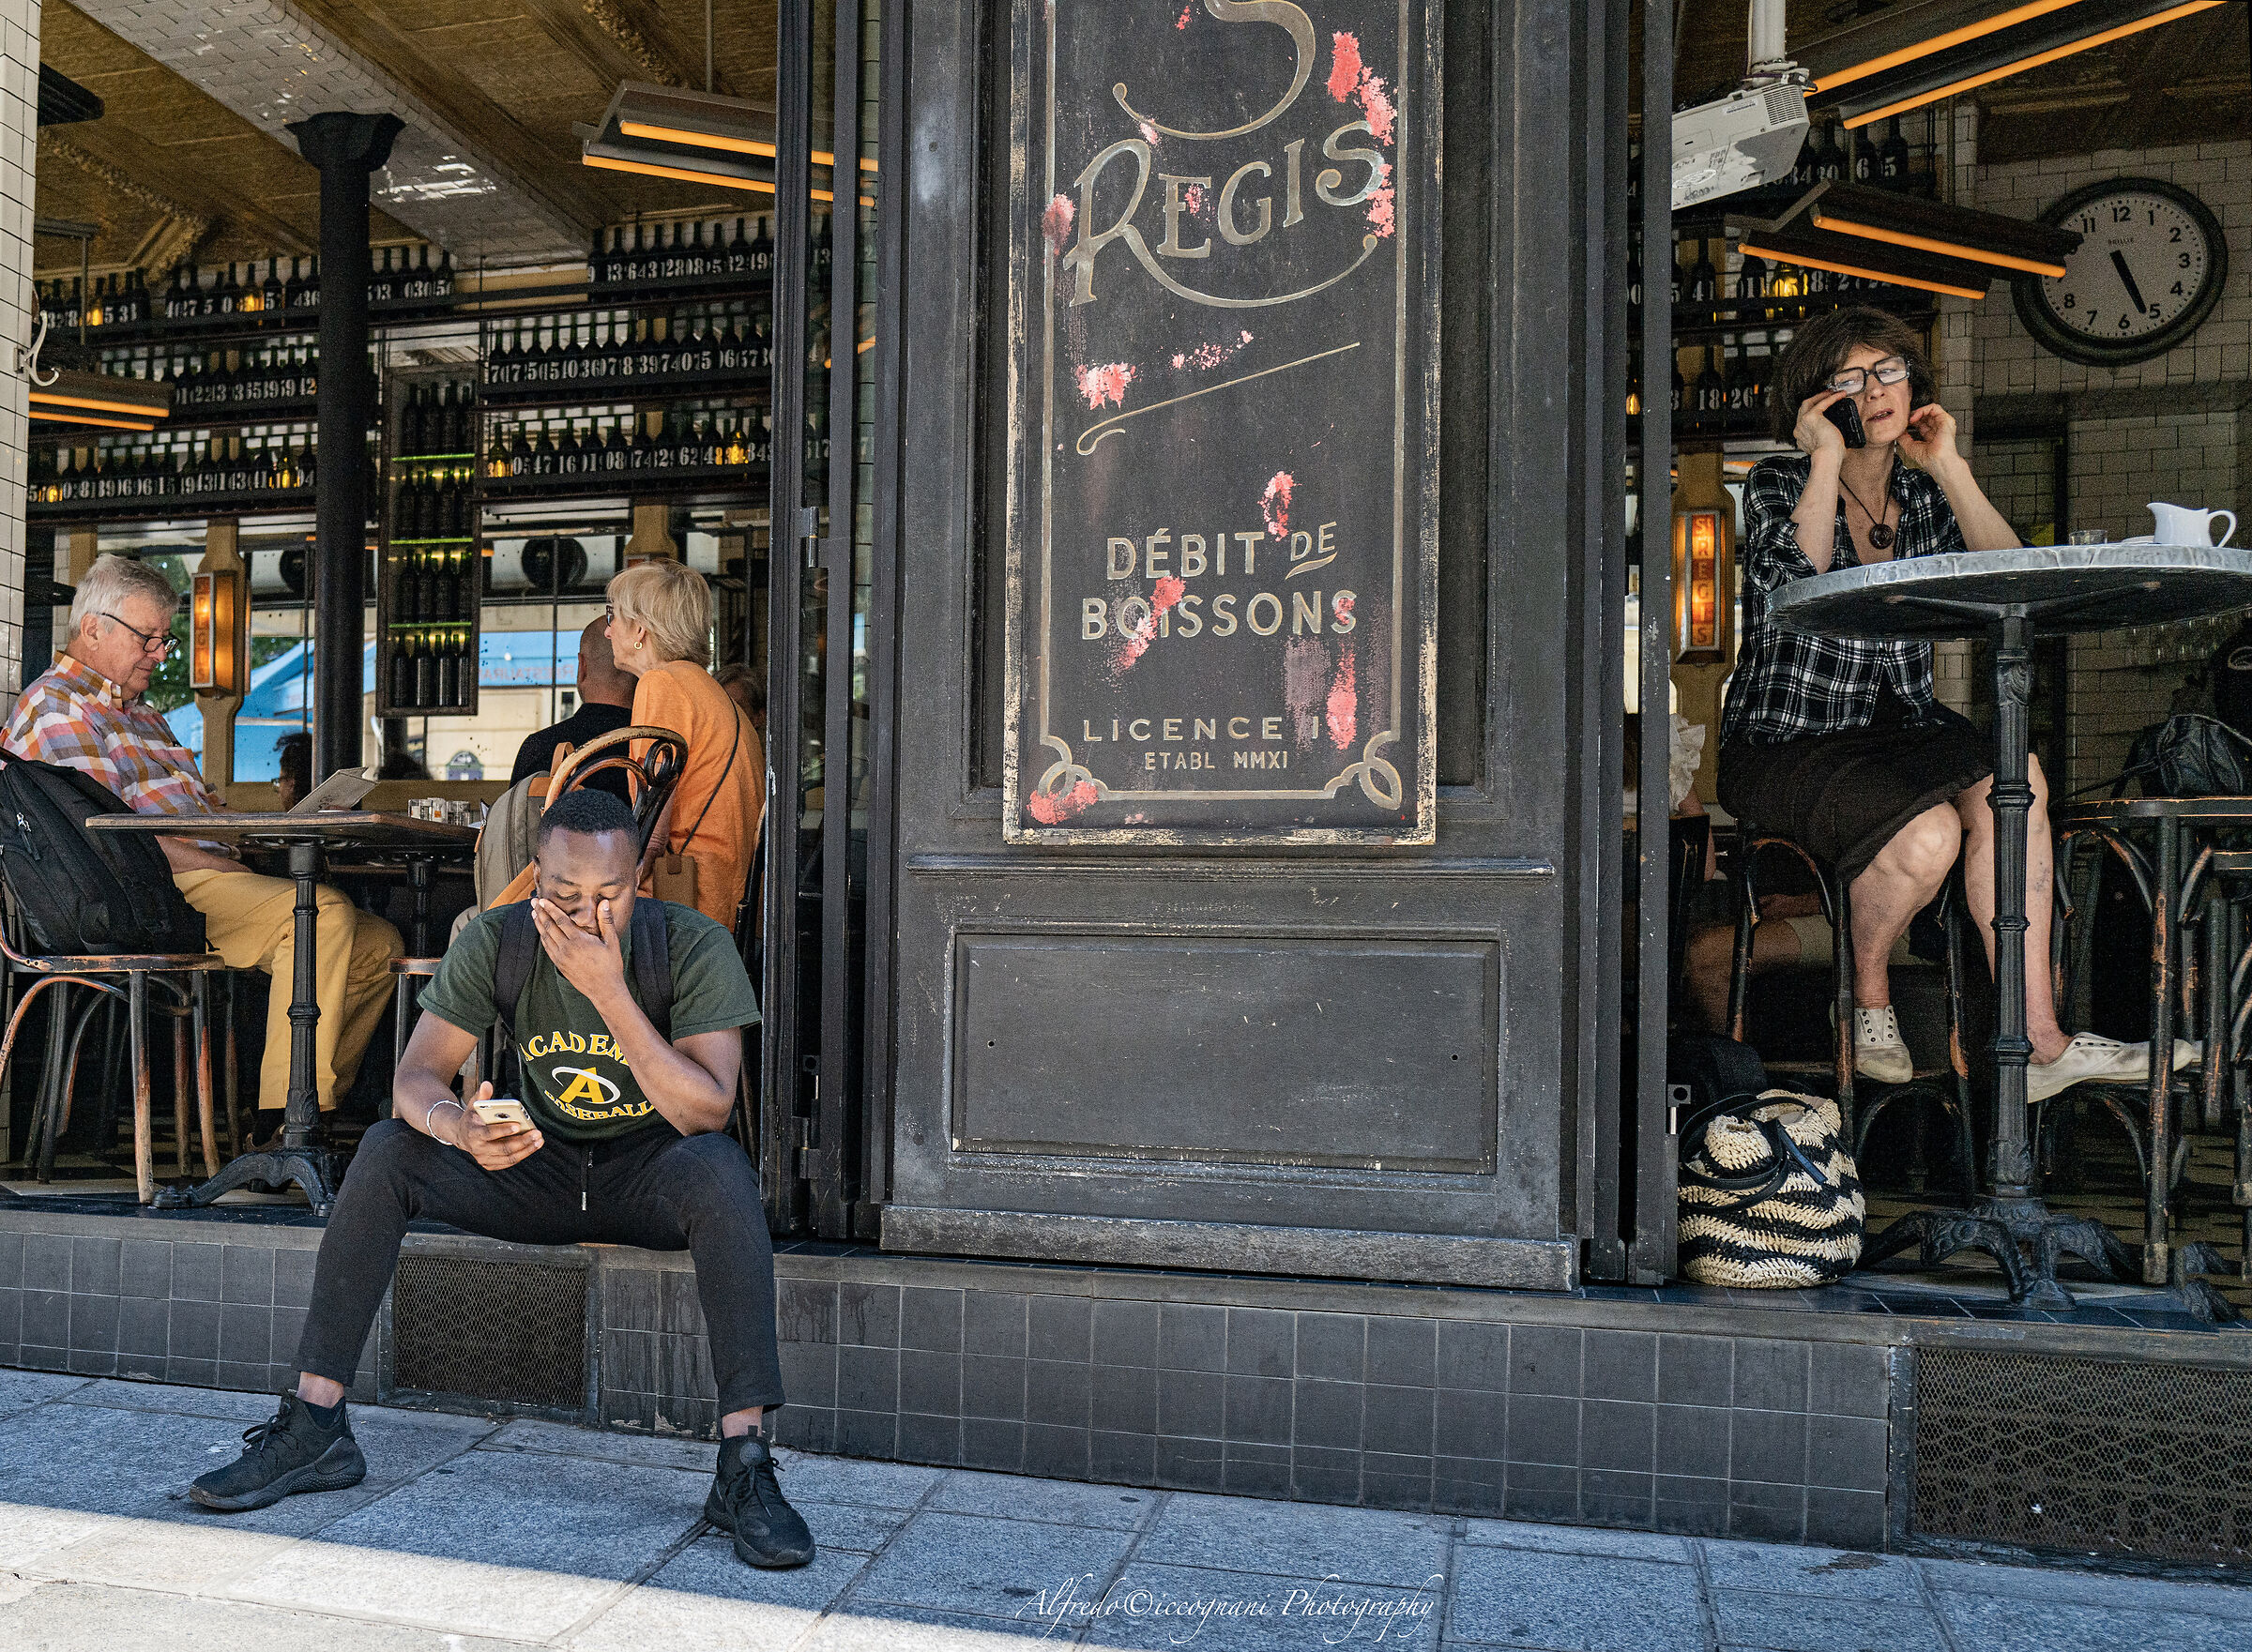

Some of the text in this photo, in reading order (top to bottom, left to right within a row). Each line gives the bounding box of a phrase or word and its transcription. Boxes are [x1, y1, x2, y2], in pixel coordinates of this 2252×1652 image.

[1063, 120, 1385, 308] REGIS
[2112, 206, 2131, 222] 12
[2148, 210, 2154, 226] 1
[2082, 218, 2095, 234] 11
[2169, 228, 2182, 242] 2
[2179, 253, 2191, 268] 3
[2170, 281, 2183, 296] 4
[2064, 294, 2076, 309] 8
[2087, 310, 2098, 326] 7
[2150, 304, 2161, 319] 5
[2118, 314, 2131, 329] 6
[1699, 388, 1720, 410] 18
[1731, 387, 1754, 409] 26
[1106, 521, 1339, 581] DÉBIT DE
[1081, 589, 1358, 641] BOISSONS
[1083, 717, 1284, 742] LICENCE
[1145, 750, 1288, 770] ETABL MMXI
